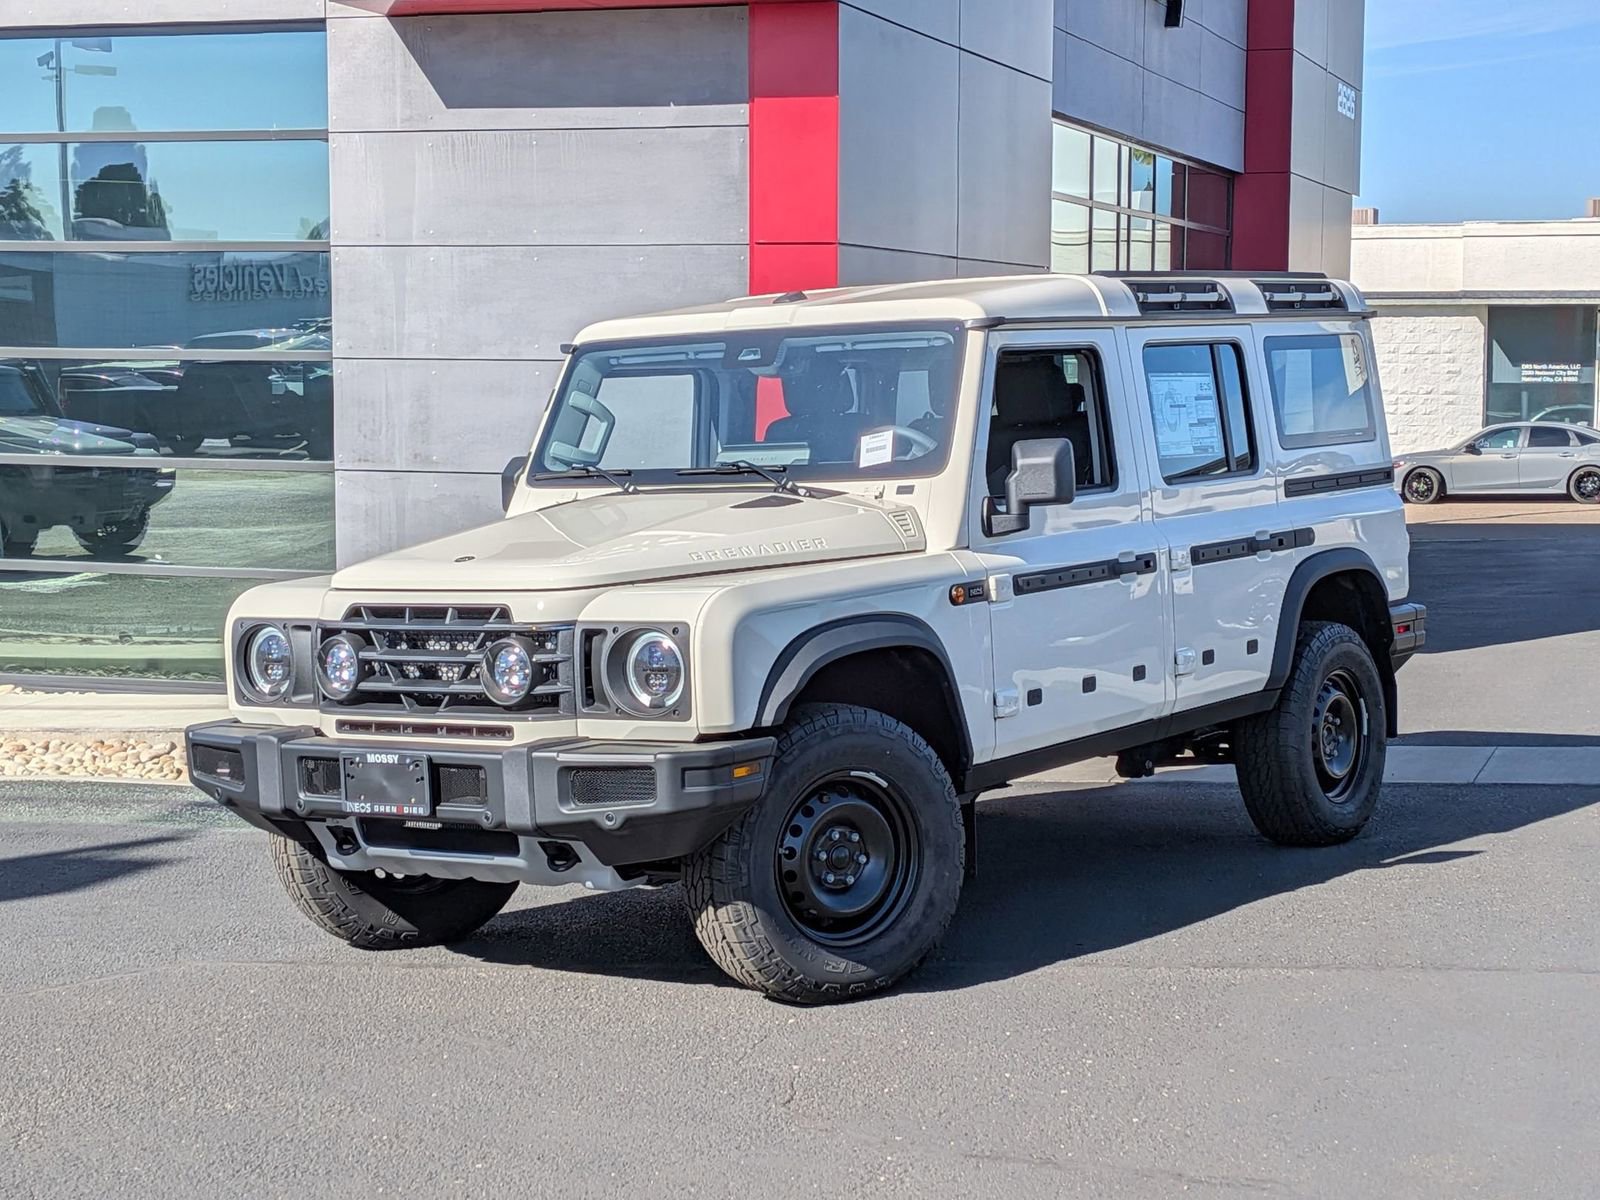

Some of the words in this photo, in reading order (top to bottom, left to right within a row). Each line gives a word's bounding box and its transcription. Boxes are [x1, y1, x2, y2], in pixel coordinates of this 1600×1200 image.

[688, 536, 829, 561] GRENADIER
[366, 753, 400, 764] MOSSY
[346, 802, 371, 813] INEOS
